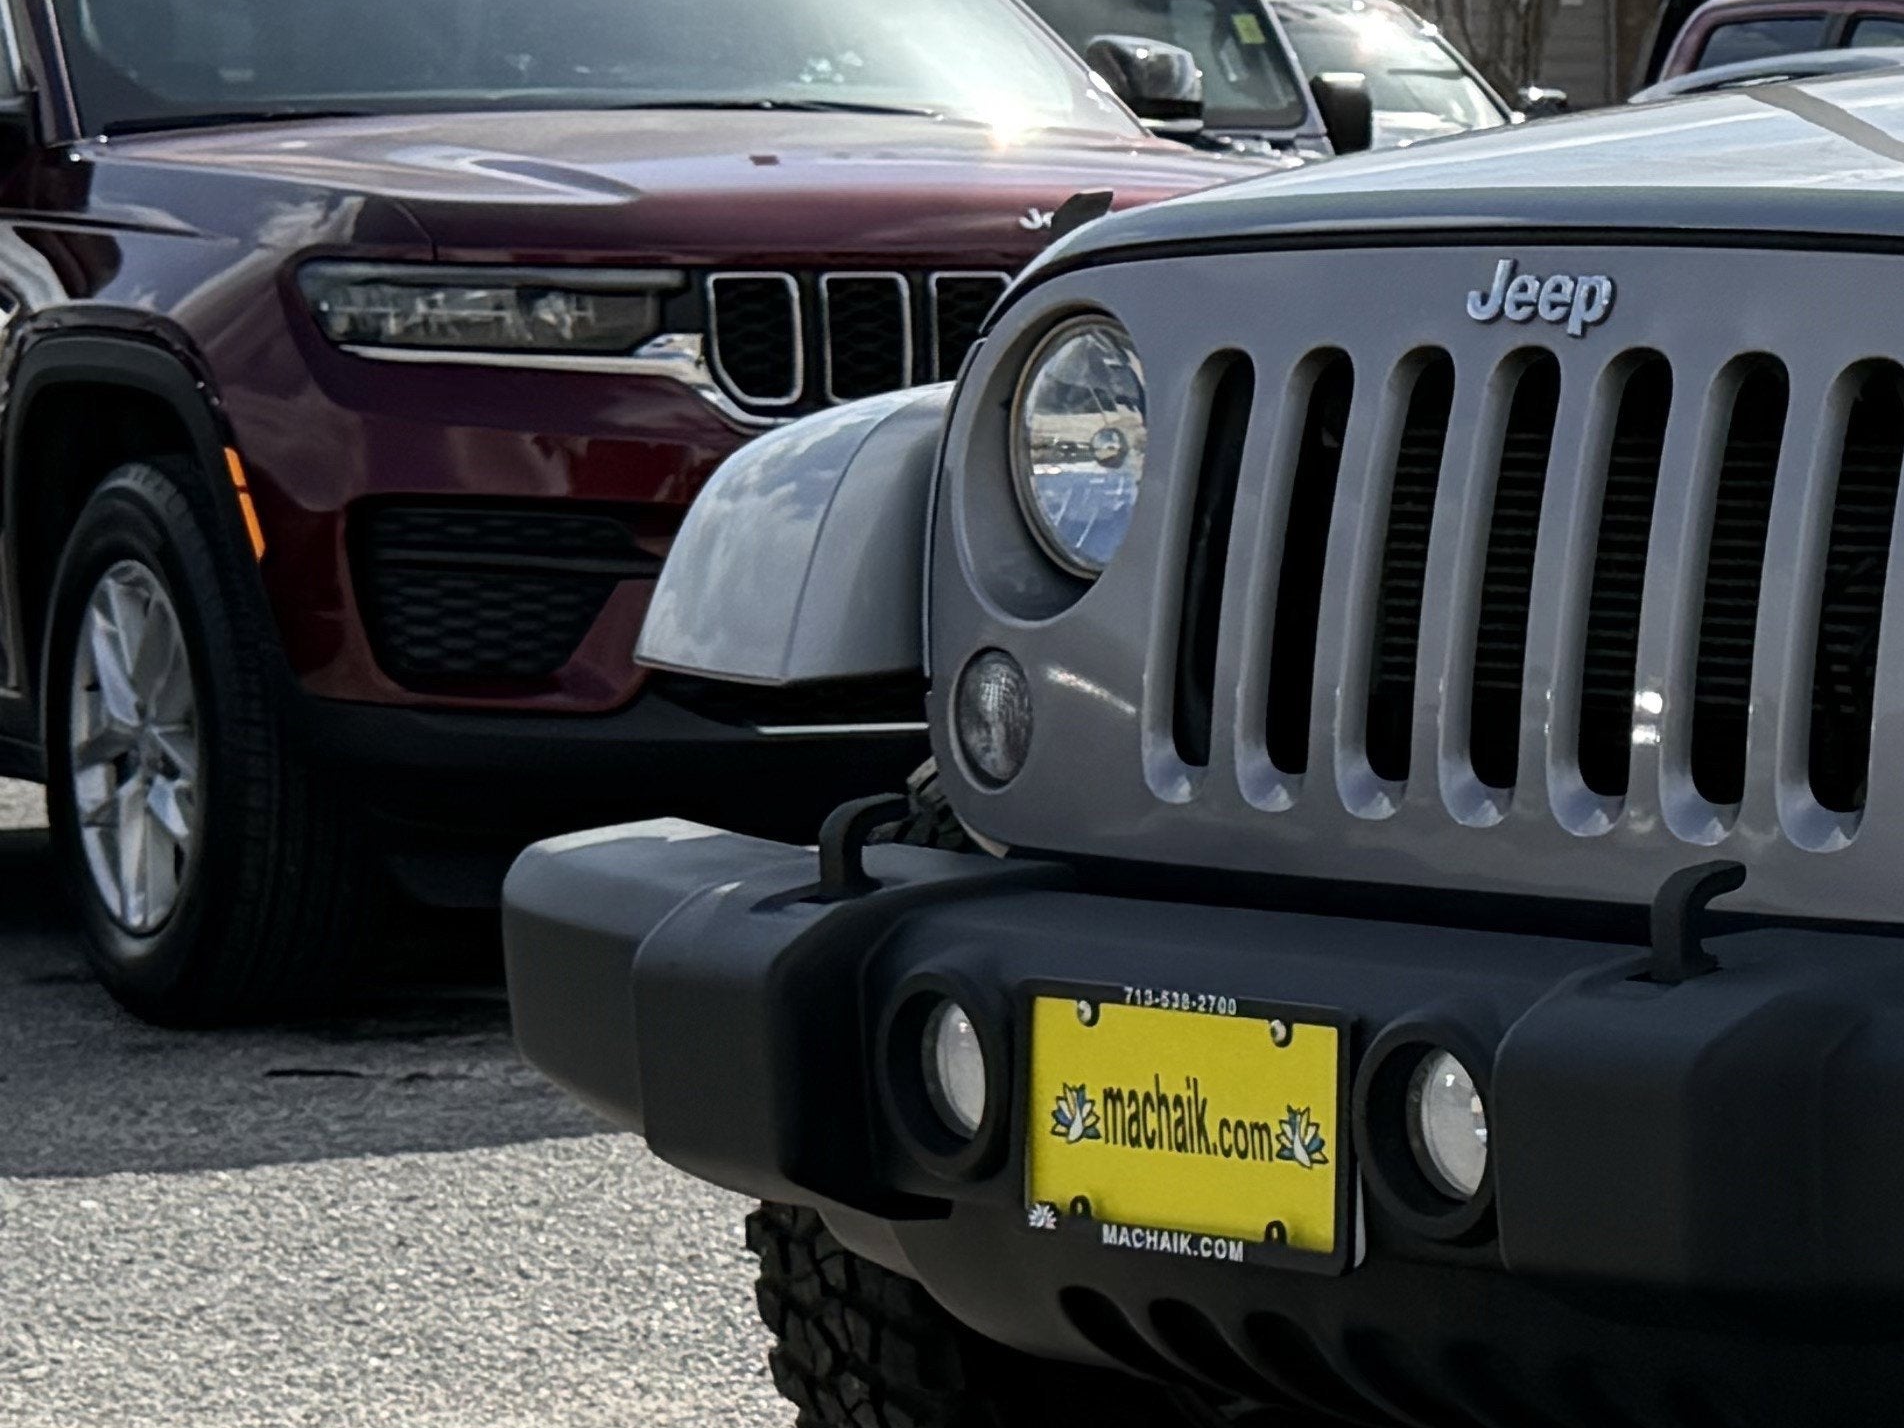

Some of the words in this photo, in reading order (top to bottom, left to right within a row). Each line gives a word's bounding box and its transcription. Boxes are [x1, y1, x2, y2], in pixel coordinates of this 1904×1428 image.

[1018, 207, 1056, 231] Je
[1466, 258, 1615, 337] Jeep
[1102, 1072, 1274, 1163] machaik.com
[1102, 1224, 1245, 1263] MACHAIK.COM
